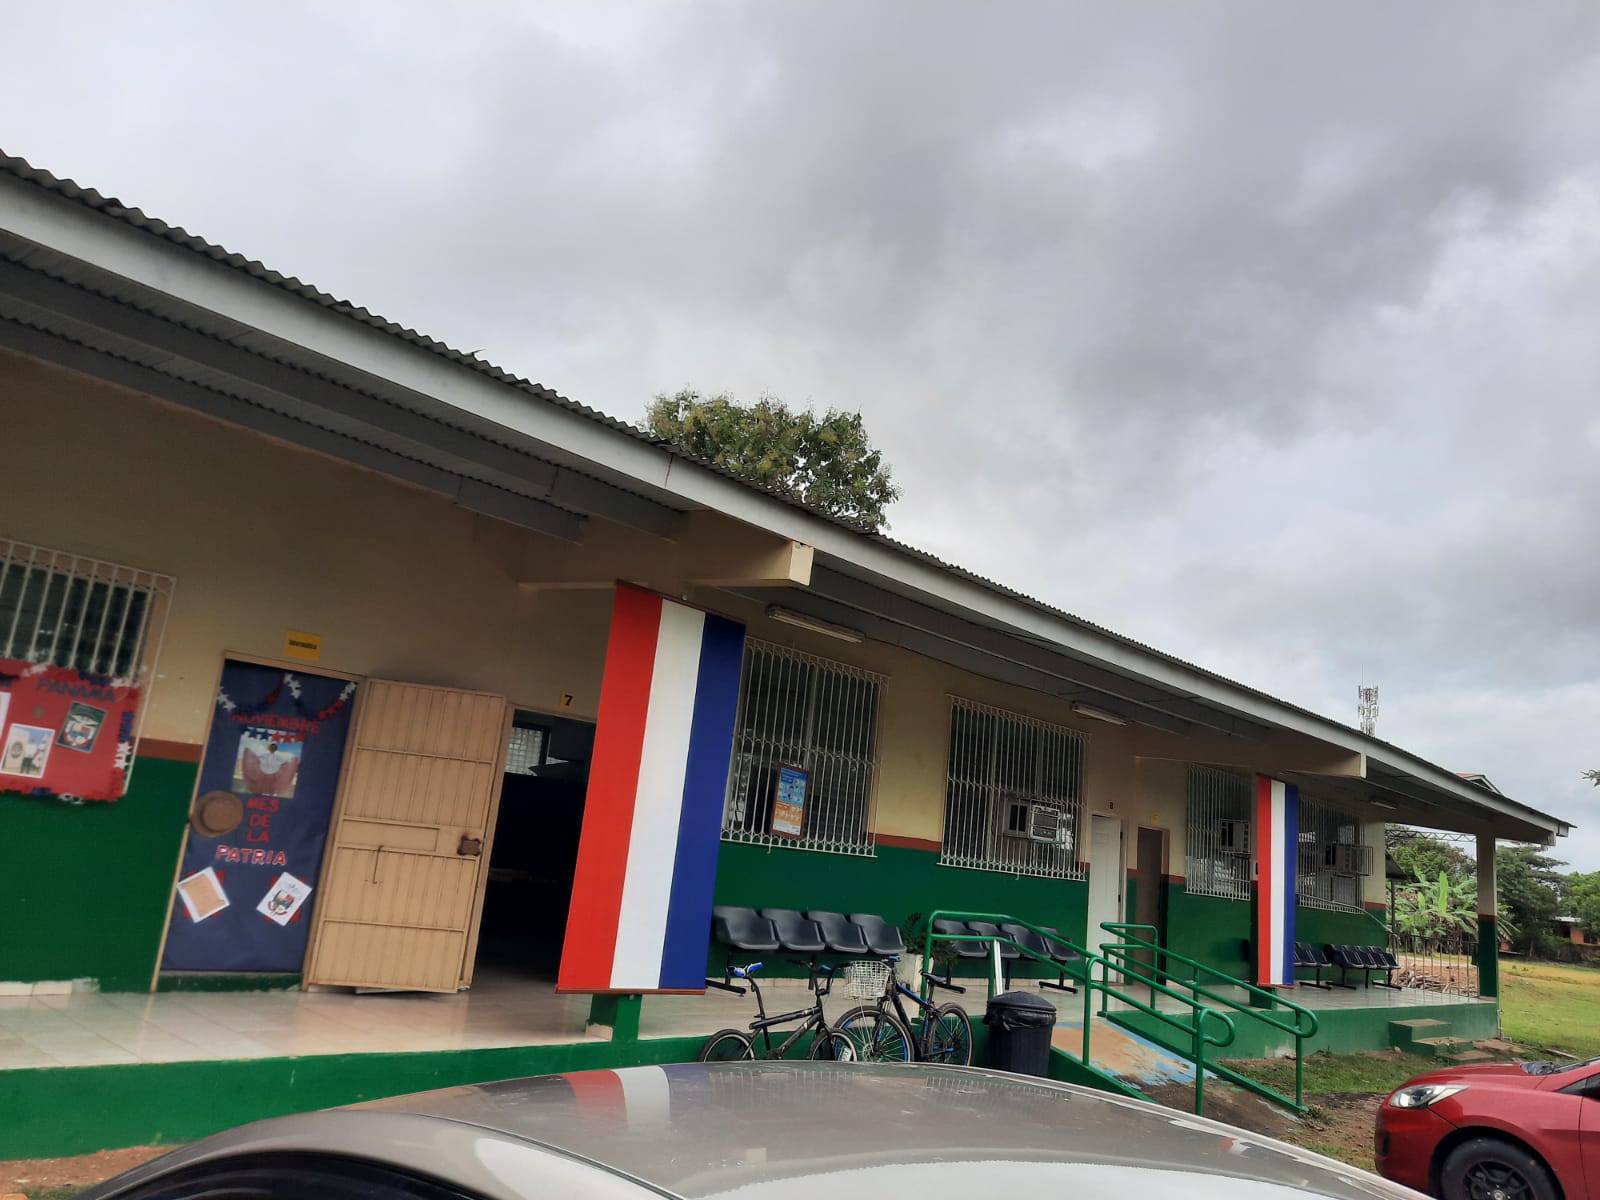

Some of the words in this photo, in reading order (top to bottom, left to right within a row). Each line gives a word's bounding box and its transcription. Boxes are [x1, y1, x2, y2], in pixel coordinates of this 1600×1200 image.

[564, 694, 574, 706] 7
[247, 796, 280, 812] MES
[249, 812, 272, 827] DE
[247, 829, 271, 843] LA
[215, 844, 288, 866] PATRIA
